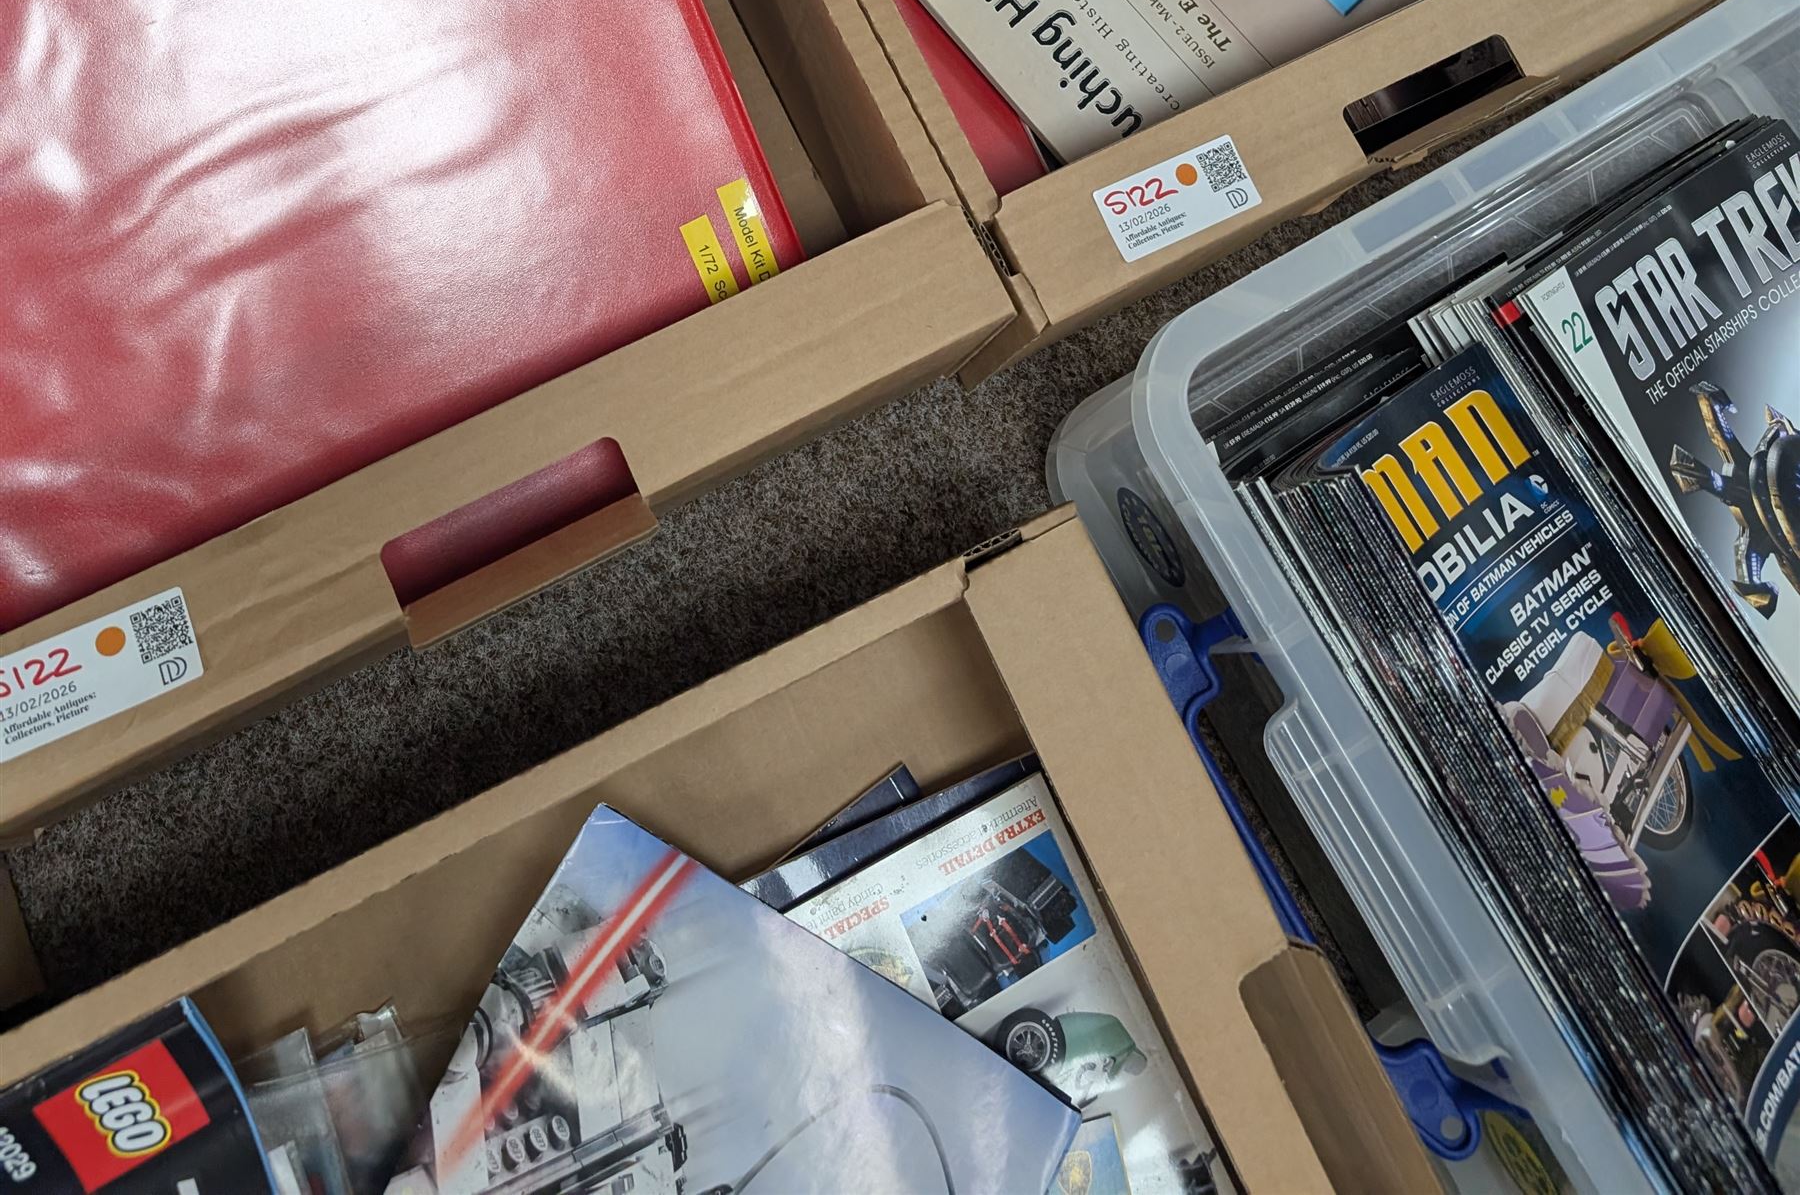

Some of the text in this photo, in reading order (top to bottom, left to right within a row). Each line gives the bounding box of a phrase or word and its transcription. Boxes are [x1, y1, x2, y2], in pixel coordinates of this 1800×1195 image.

[1175, 25, 1186, 36] 2
[1197, 12, 1233, 53] The
[1745, 132, 1786, 164] EAGLEMOSS
[733, 206, 758, 248] Model
[750, 249, 766, 269] Kit
[1118, 203, 1172, 234] 13/02/2026
[1124, 223, 1158, 243] Affordable
[1162, 220, 1185, 235] Picture
[699, 244, 719, 275] 1/72
[1594, 237, 1723, 381] STAR
[1561, 311, 1593, 354] 22
[1645, 273, 1800, 405] THE OFFICIAL STARSHIPS COLLE
[1430, 365, 1478, 401] EAGLEMOSS
[1458, 598, 1472, 619] OF
[1470, 554, 1516, 602] BATMAN
[1515, 510, 1574, 560] VEHICLES
[1485, 569, 1602, 685] CLASSIC TV SERIES
[1514, 585, 1613, 682] BATGIRL CYCLE
[3, 709, 52, 736] Affordable
[56, 704, 90, 724] Picture
[937, 808, 1047, 877] EXTRA DETAIL
[824, 896, 891, 940] SPECIAL
[75, 1069, 172, 1158] LEGO
[0, 1127, 37, 1182] 2029
